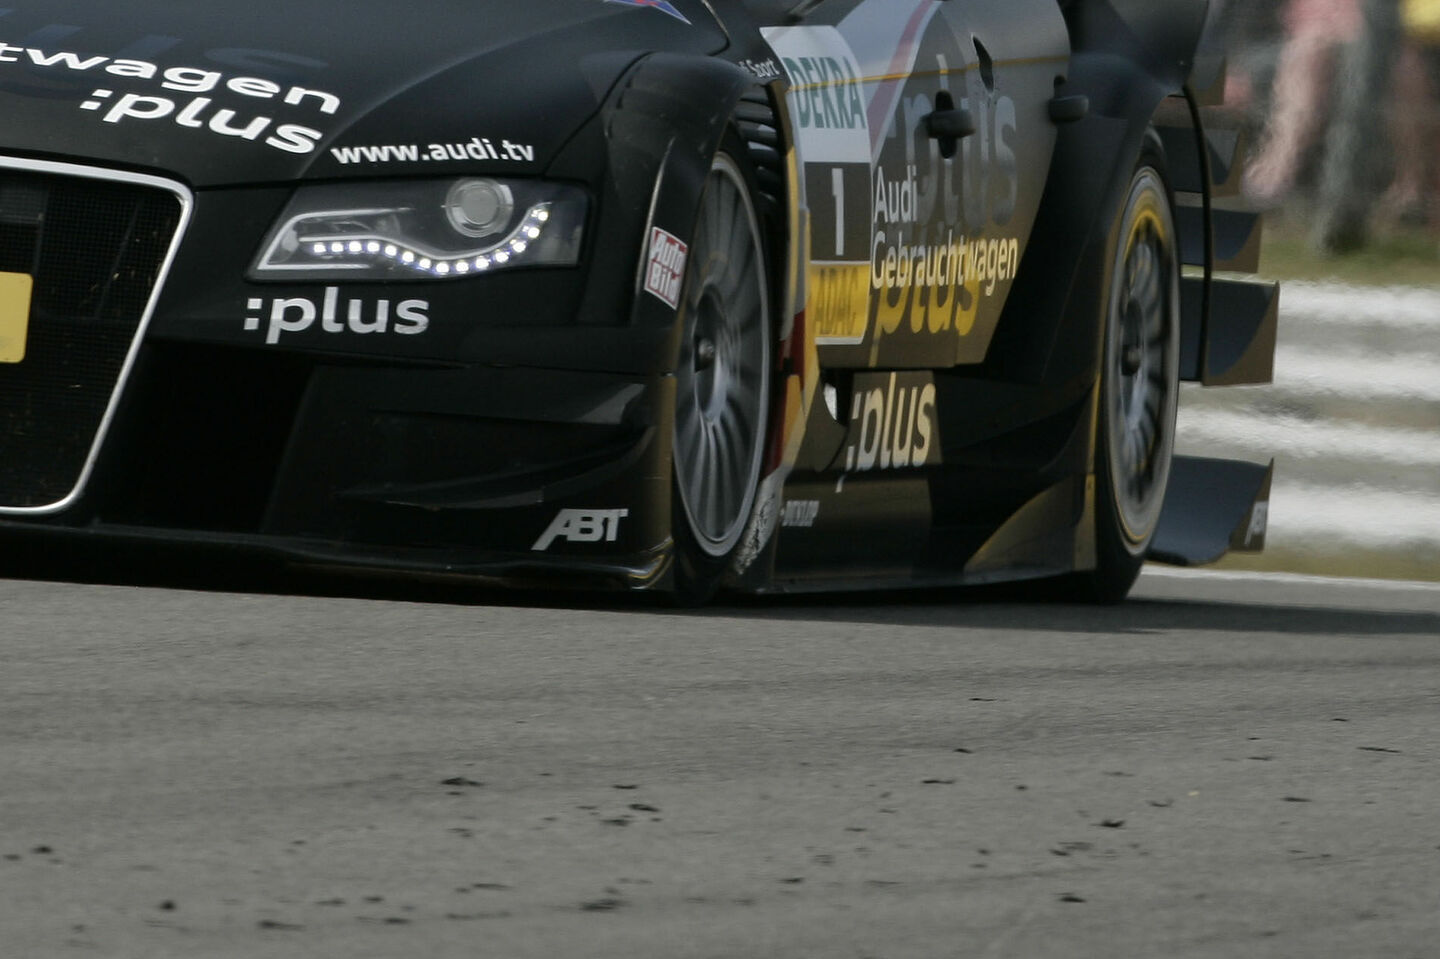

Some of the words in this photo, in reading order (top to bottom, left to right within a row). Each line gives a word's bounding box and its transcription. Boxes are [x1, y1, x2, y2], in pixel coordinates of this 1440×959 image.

[79, 88, 324, 156] :plus
[783, 57, 867, 129] DEKRA
[331, 137, 535, 167] www.audi.tv
[831, 168, 845, 257] 1
[873, 164, 918, 224] Audi
[871, 229, 1019, 297] Gebrauchtwagen
[243, 286, 430, 344] :plus
[530, 508, 629, 551] ABT
